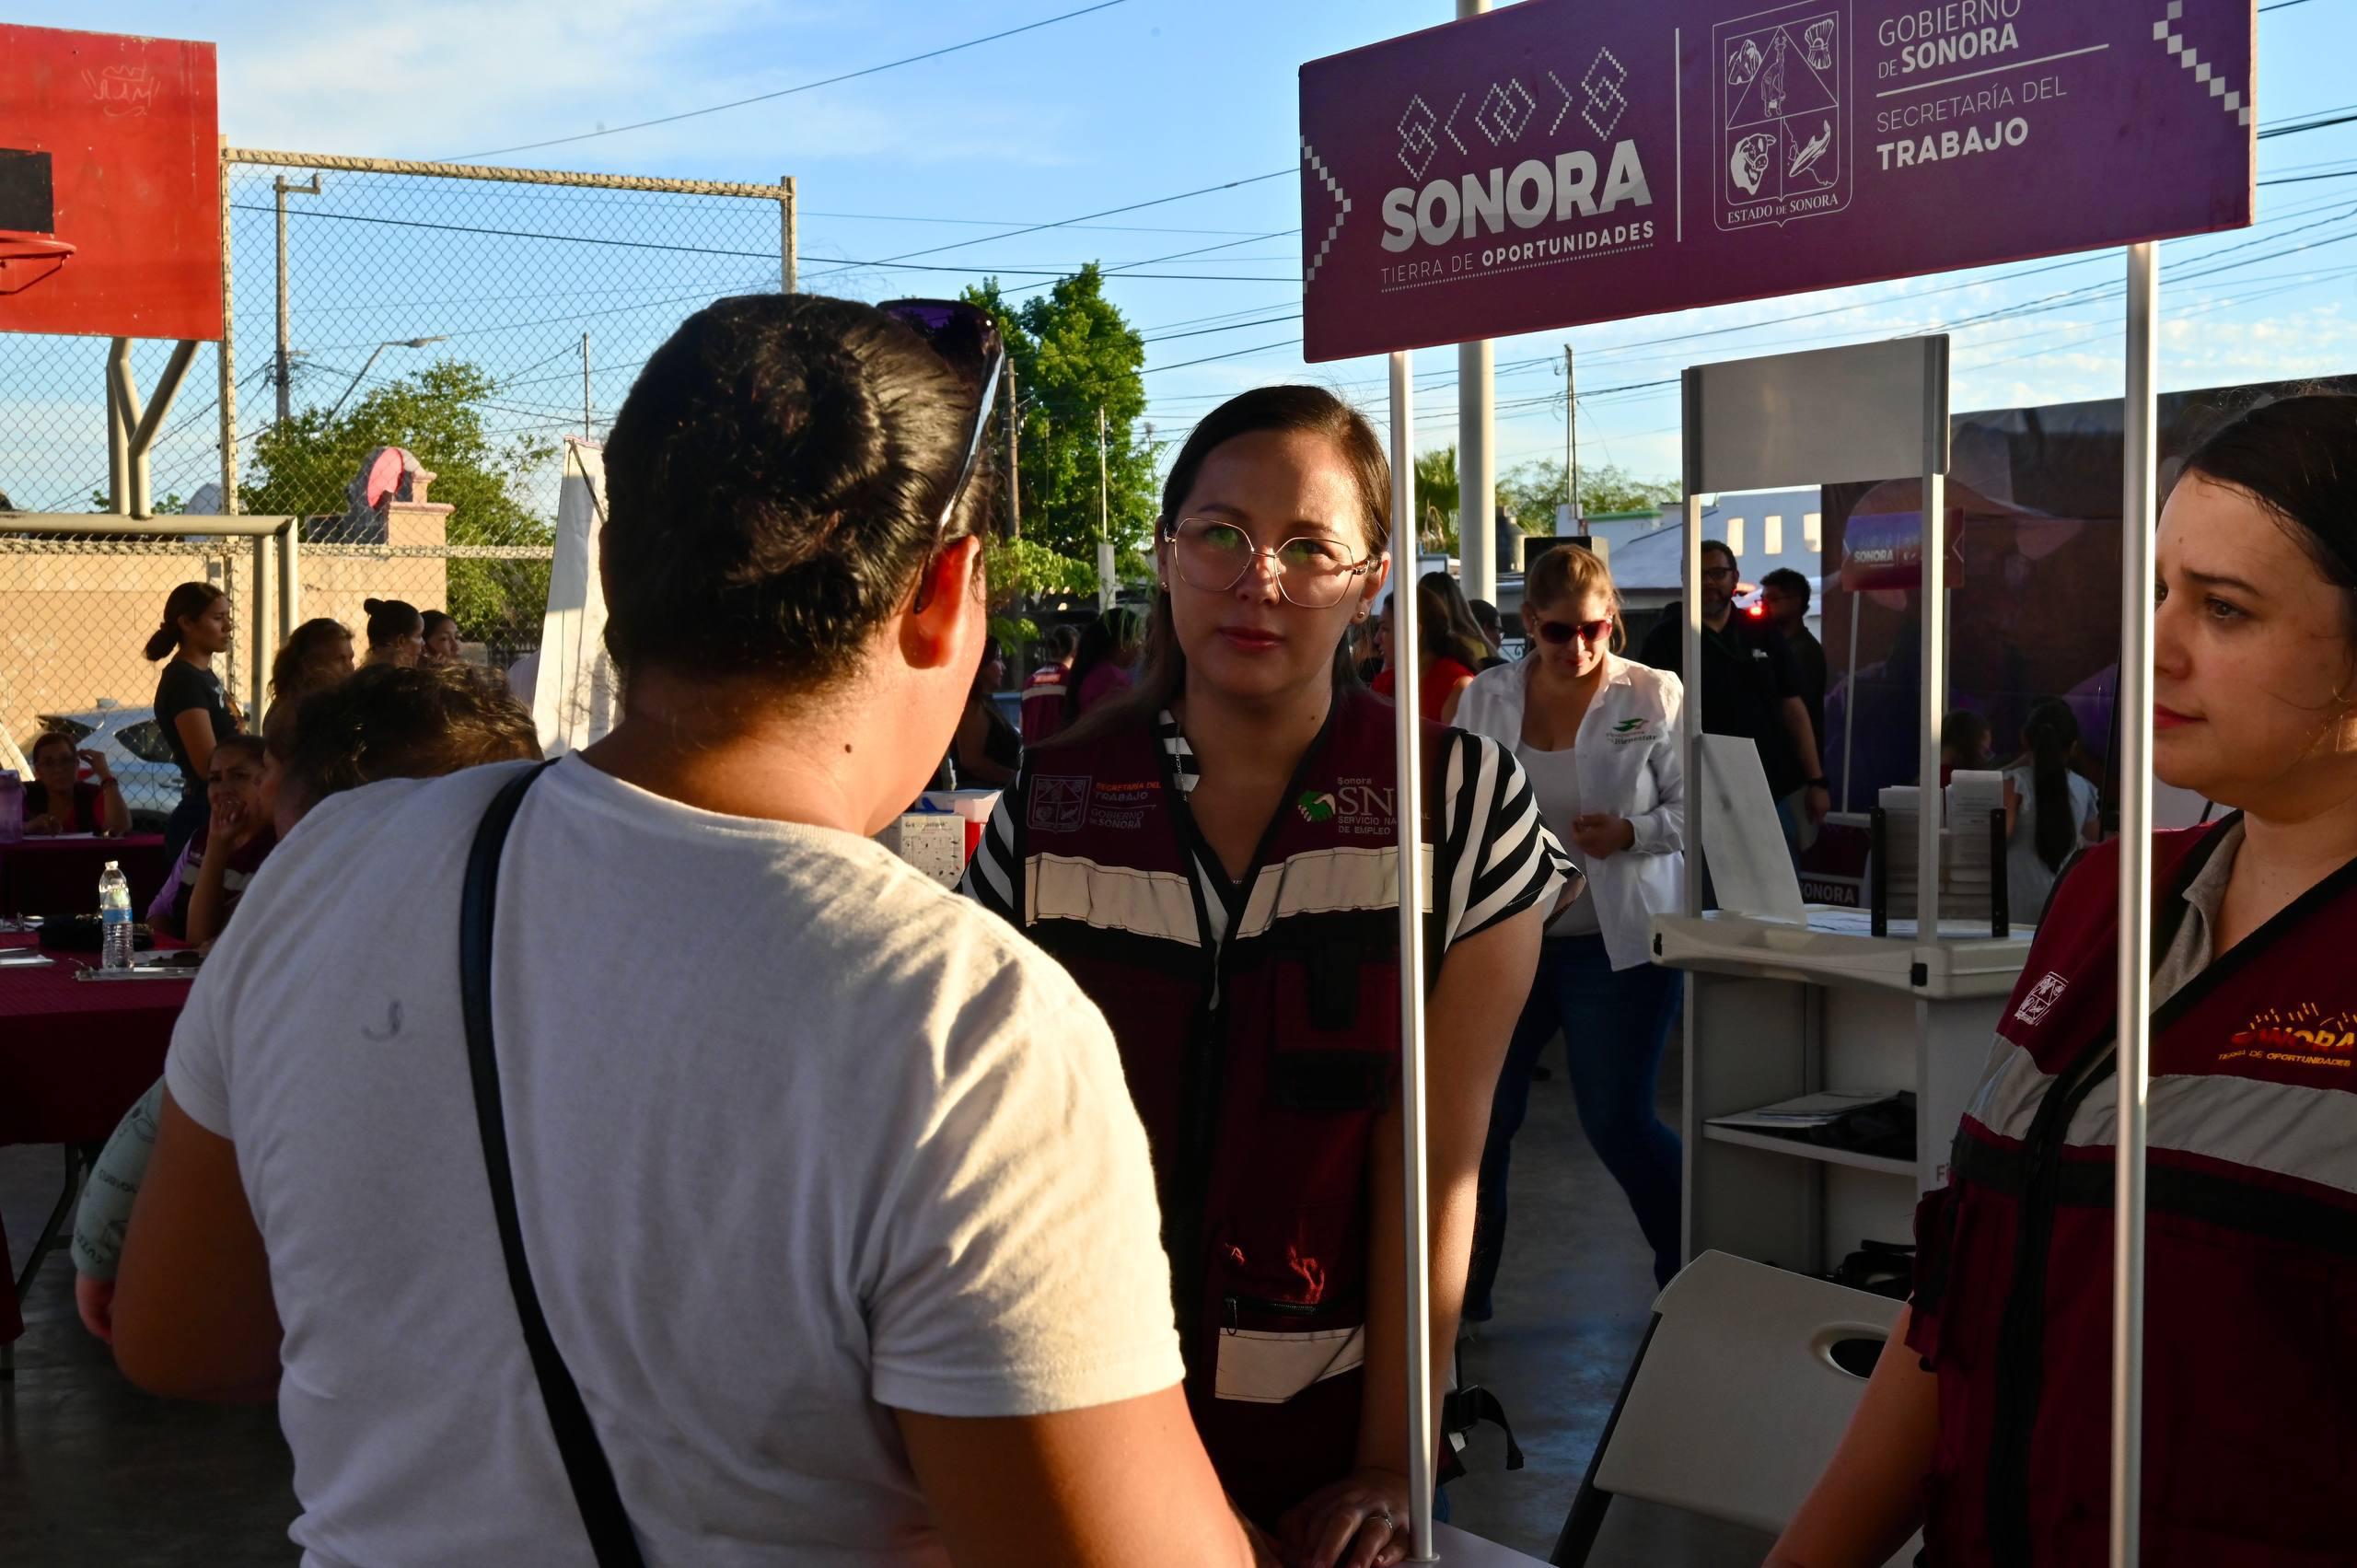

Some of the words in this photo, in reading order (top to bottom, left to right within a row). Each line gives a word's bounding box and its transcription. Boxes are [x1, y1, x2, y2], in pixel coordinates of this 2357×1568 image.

[1878, 0, 2021, 47] GOBIERNO
[1878, 59, 1898, 79] DE
[1901, 22, 2019, 74] SONORA
[1876, 82, 2014, 133] SECRETARÍA
[2023, 75, 2068, 103] DEL
[1876, 117, 2029, 170] TRABAJO
[1381, 139, 1654, 253] SONORA
[1727, 204, 1773, 224] ESTADO
[1775, 205, 1787, 216] DE
[1790, 193, 1839, 214] SONORA
[1381, 259, 1444, 285] TIERRA
[1452, 252, 1474, 273] DE
[1481, 220, 1655, 267] OPORTUNIDADES
[1853, 549, 1895, 563] SONORA
[1096, 791, 1149, 802] TRABAJO
[1098, 818, 1142, 830] SONORA
[1338, 815, 1380, 826] SERVICIO
[1338, 825, 1352, 834] DE
[1354, 826, 1392, 836] EMPLEO
